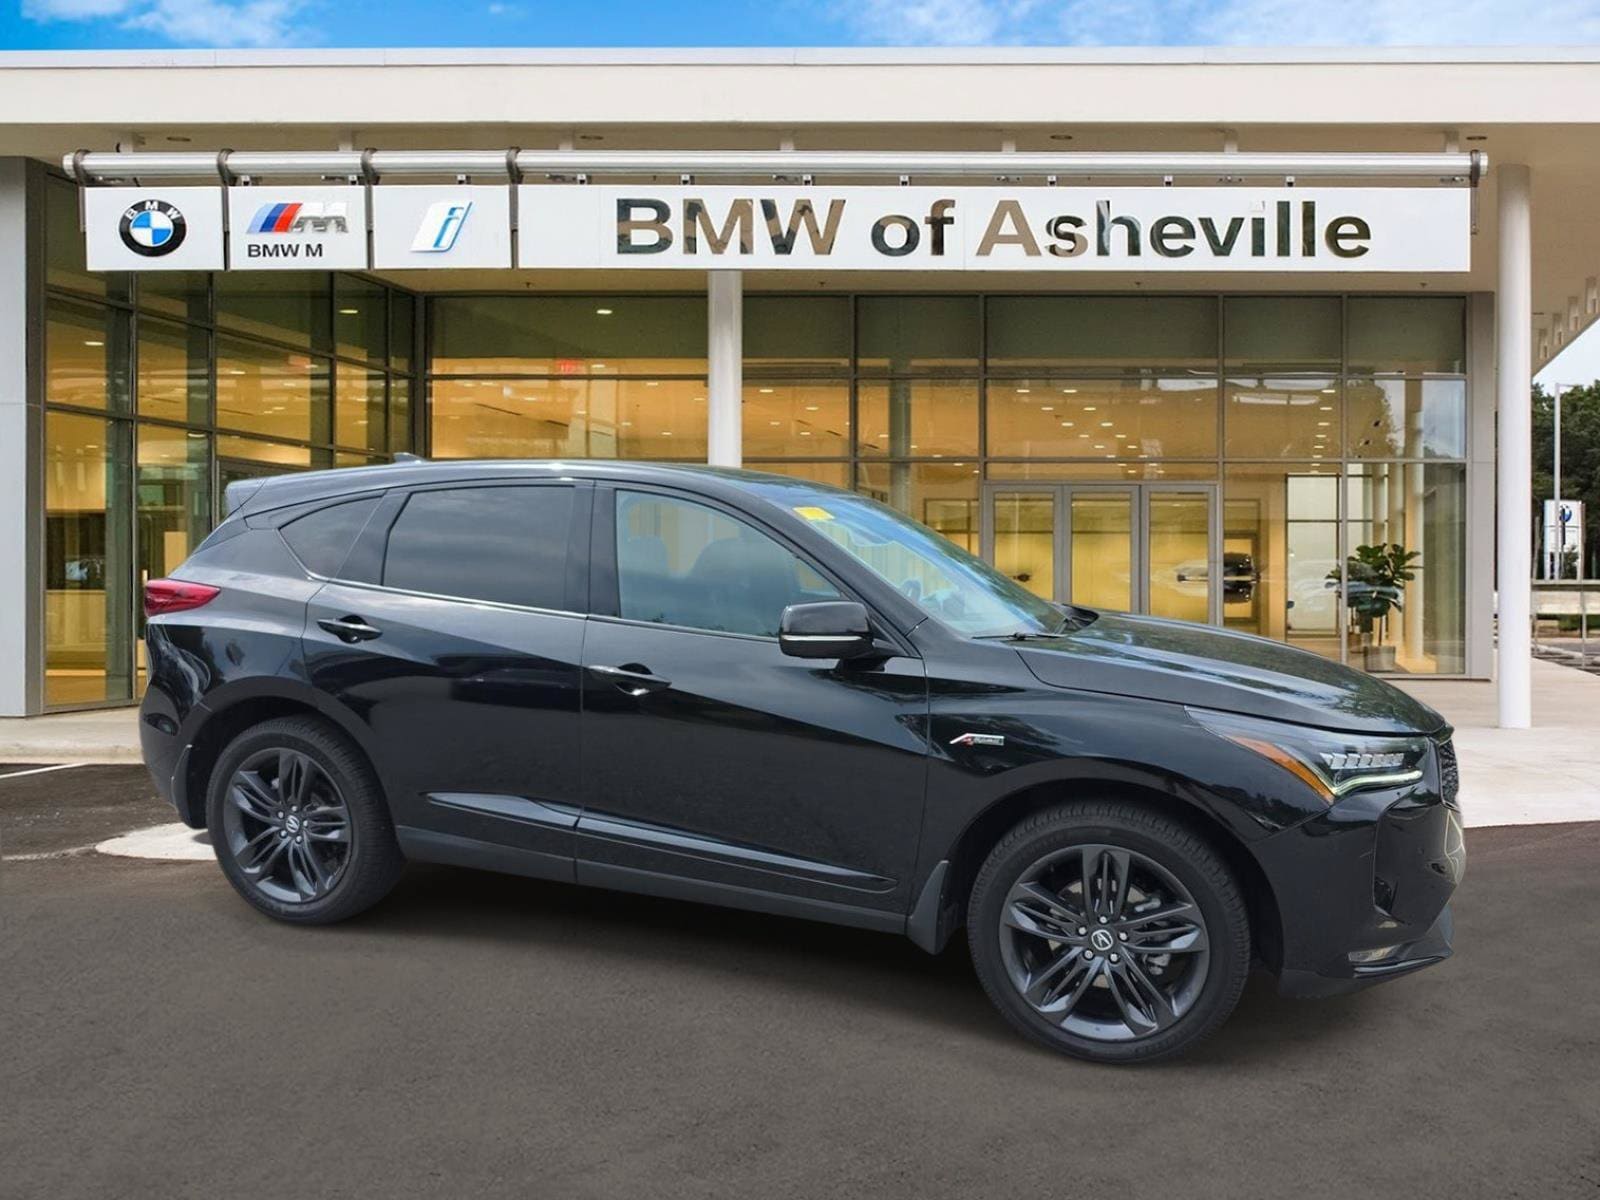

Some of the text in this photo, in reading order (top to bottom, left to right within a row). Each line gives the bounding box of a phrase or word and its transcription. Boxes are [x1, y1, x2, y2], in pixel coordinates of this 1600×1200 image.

[125, 200, 181, 220] BMW
[616, 198, 1372, 258] BMW of Asheville
[247, 243, 323, 258] BMW M
